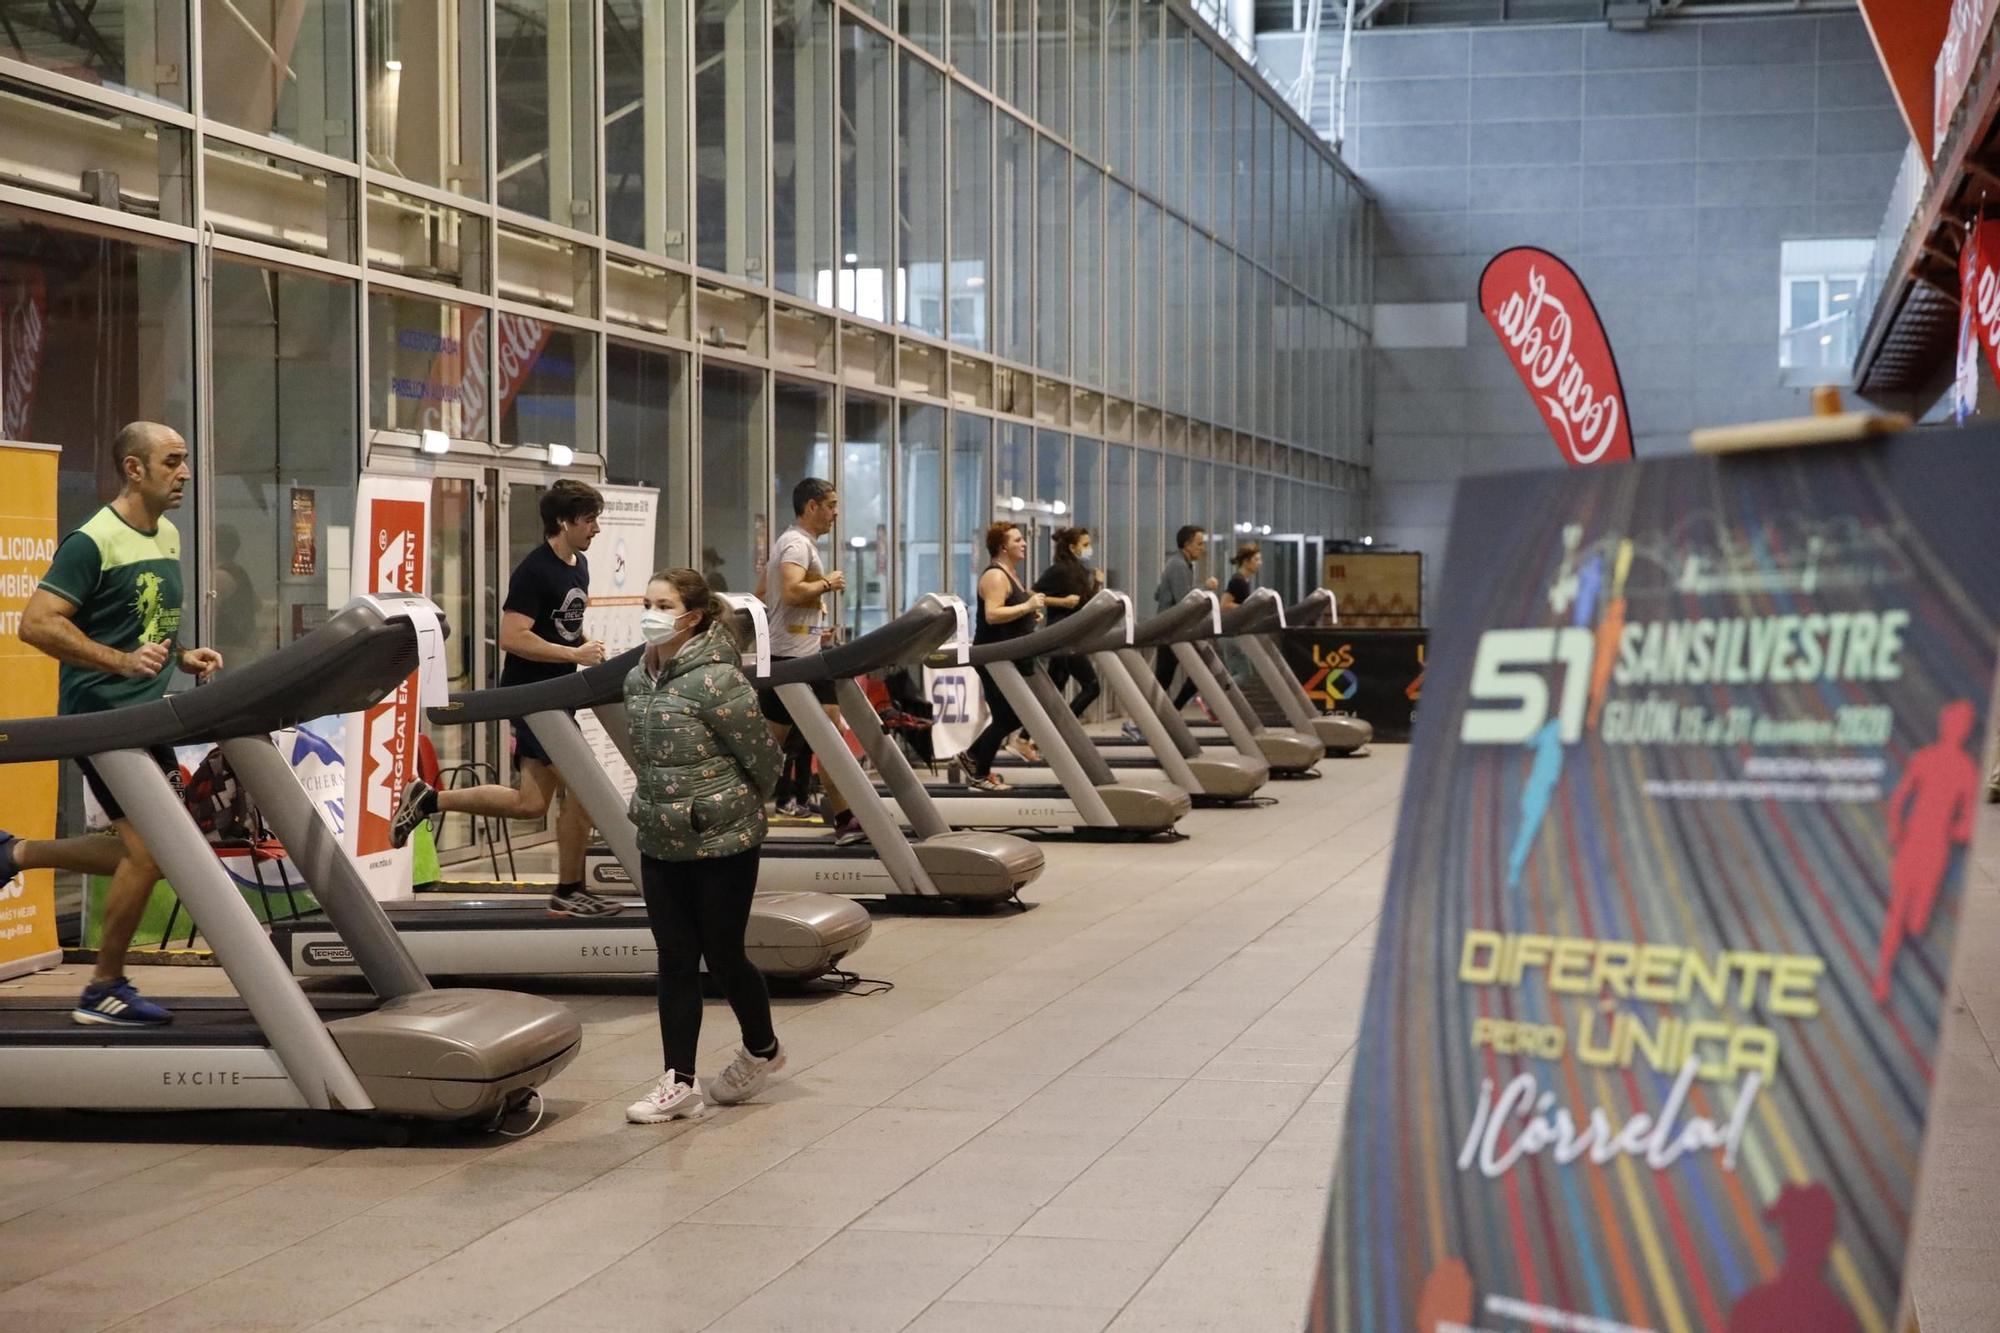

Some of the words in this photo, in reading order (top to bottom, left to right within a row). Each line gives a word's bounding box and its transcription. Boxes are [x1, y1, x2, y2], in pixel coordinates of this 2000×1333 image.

[367, 529, 406, 821] MA
[1460, 626, 1594, 746] 51
[1612, 607, 1910, 686] SANSILVESTRE
[391, 711, 408, 815] URGICAL
[1018, 808, 1056, 816] EXCITE
[816, 871, 861, 881] EXCITE
[310, 947, 353, 959] TECHNOG
[581, 945, 639, 957] EXCITE
[1459, 928, 1826, 1019] DIFERENTE
[1470, 1017, 1567, 1060] PERO
[1577, 999, 1780, 1088] ÚNICA
[163, 1071, 240, 1085] EXCITE
